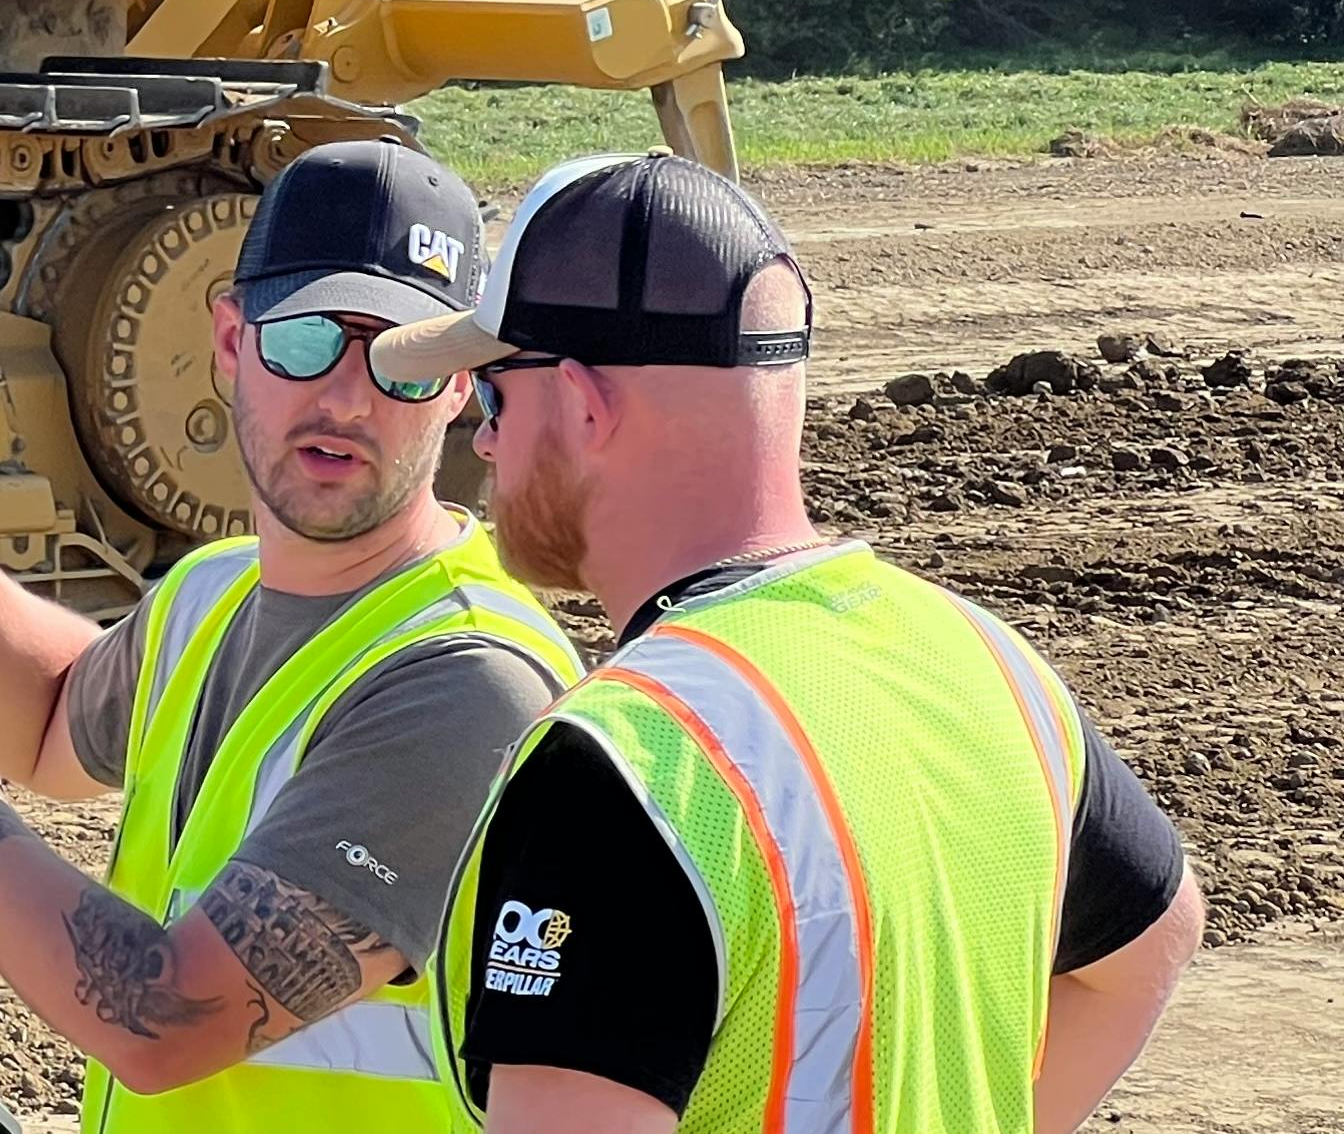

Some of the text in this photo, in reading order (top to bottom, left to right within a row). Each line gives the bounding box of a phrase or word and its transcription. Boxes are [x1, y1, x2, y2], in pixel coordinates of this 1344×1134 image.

[408, 223, 464, 283] CAT
[832, 585, 881, 614] GEAR
[335, 840, 399, 885] FORCE
[493, 900, 572, 949] 00
[490, 940, 561, 970] EARS
[485, 968, 555, 996] ERPILLAR
